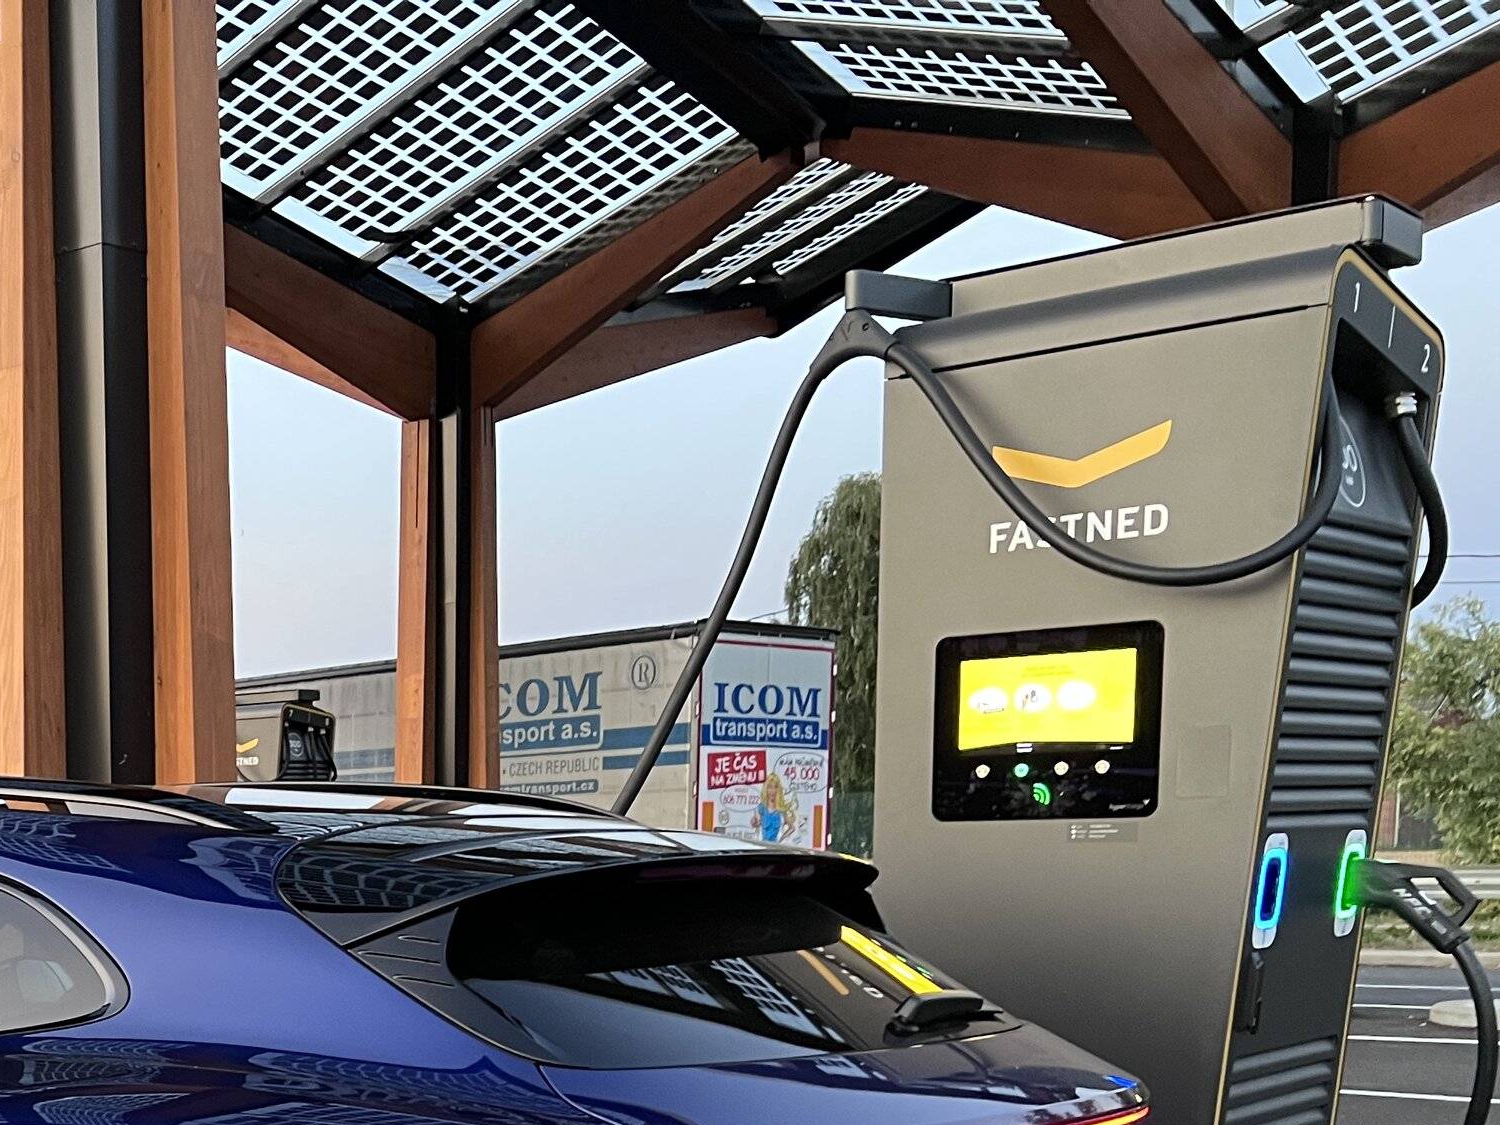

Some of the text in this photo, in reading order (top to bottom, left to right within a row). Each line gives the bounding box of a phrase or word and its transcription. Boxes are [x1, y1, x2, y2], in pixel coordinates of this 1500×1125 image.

[1353, 282, 1361, 313] 1
[1420, 343, 1431, 374] 2
[713, 682, 822, 718] ICOM
[500, 720, 598, 749] sport a.s.
[715, 718, 818, 742] transport a.s.
[508, 756, 600, 777] CZECH REPUBLIC
[714, 752, 758, 773] JE ČAS
